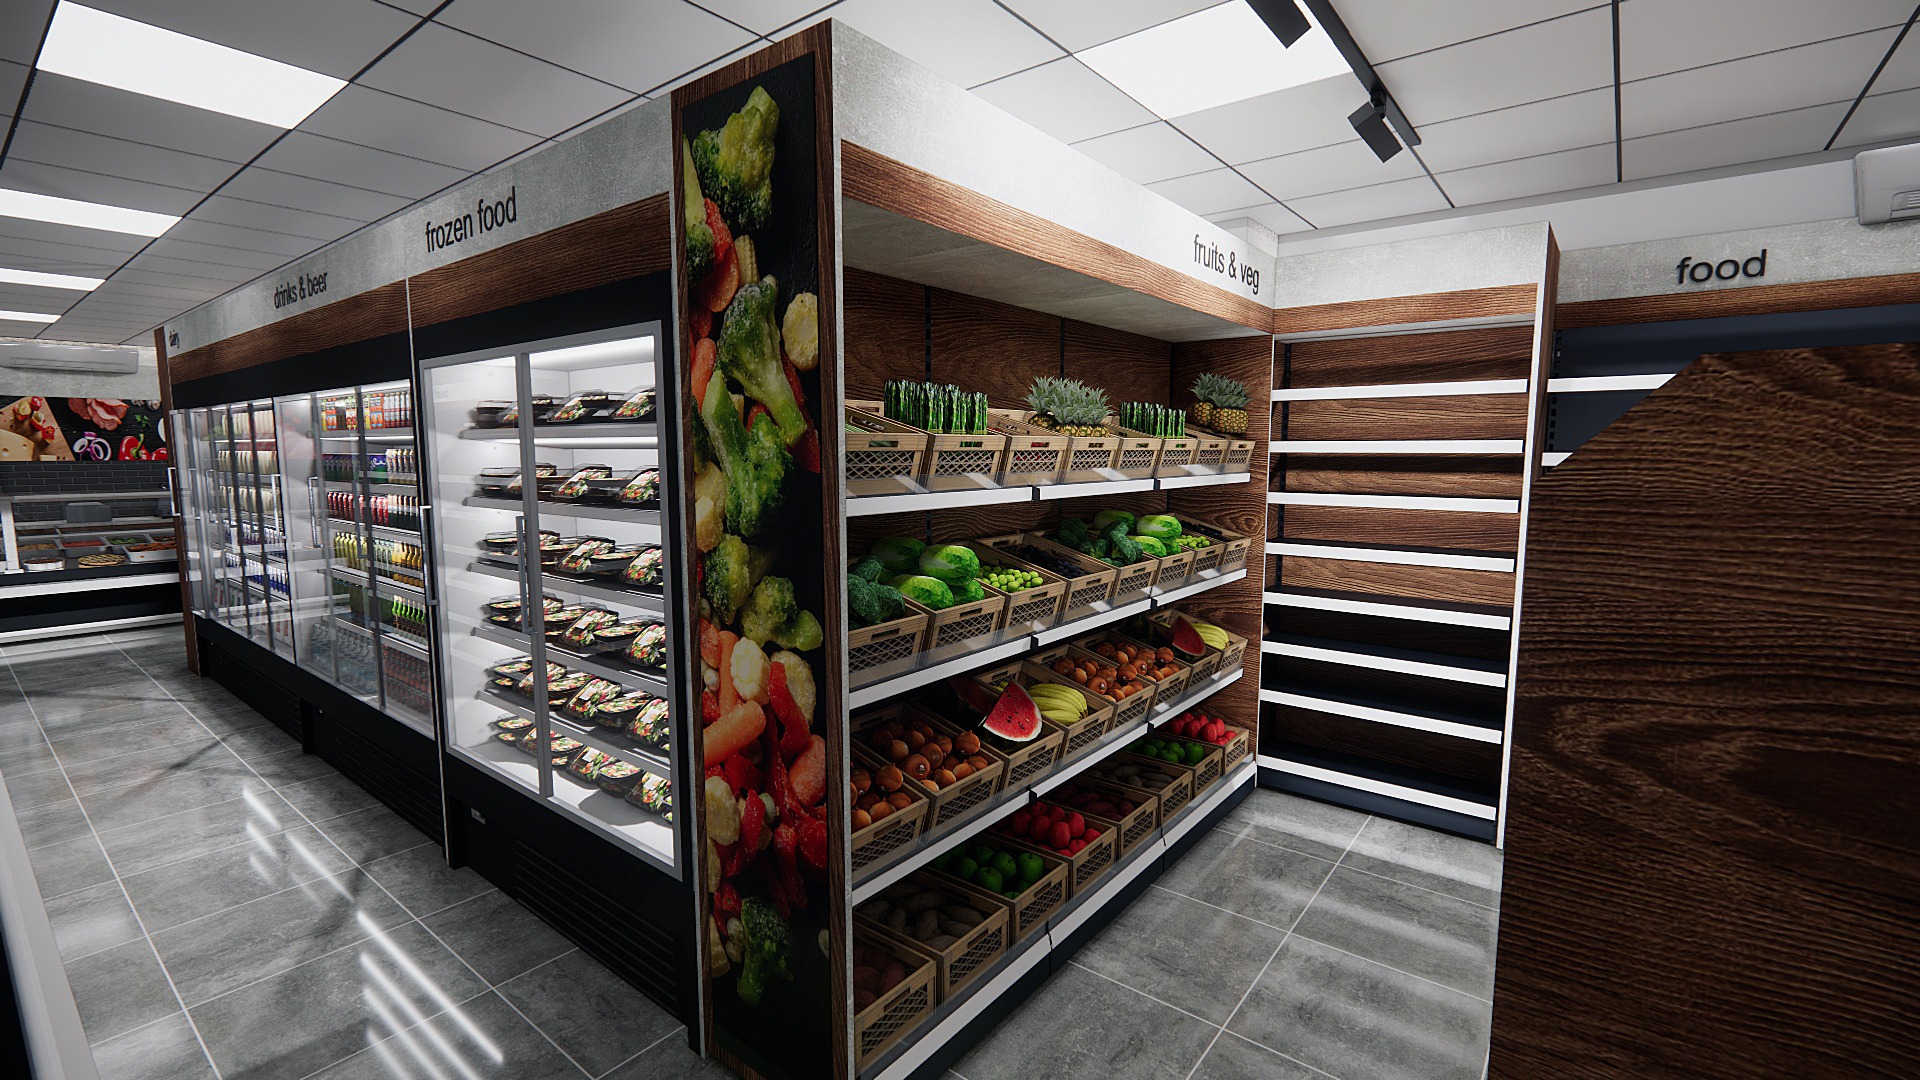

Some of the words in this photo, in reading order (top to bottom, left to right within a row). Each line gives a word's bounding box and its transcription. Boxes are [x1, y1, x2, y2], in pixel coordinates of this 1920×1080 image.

[426, 213, 473, 253] frozen
[477, 186, 517, 234] food
[1194, 233, 1225, 274] fruits
[1228, 251, 1237, 280] &
[1240, 263, 1260, 295] veg
[1676, 248, 1768, 284] food
[274, 282, 297, 309] drinks
[299, 275, 306, 300] &
[307, 272, 328, 297] beer
